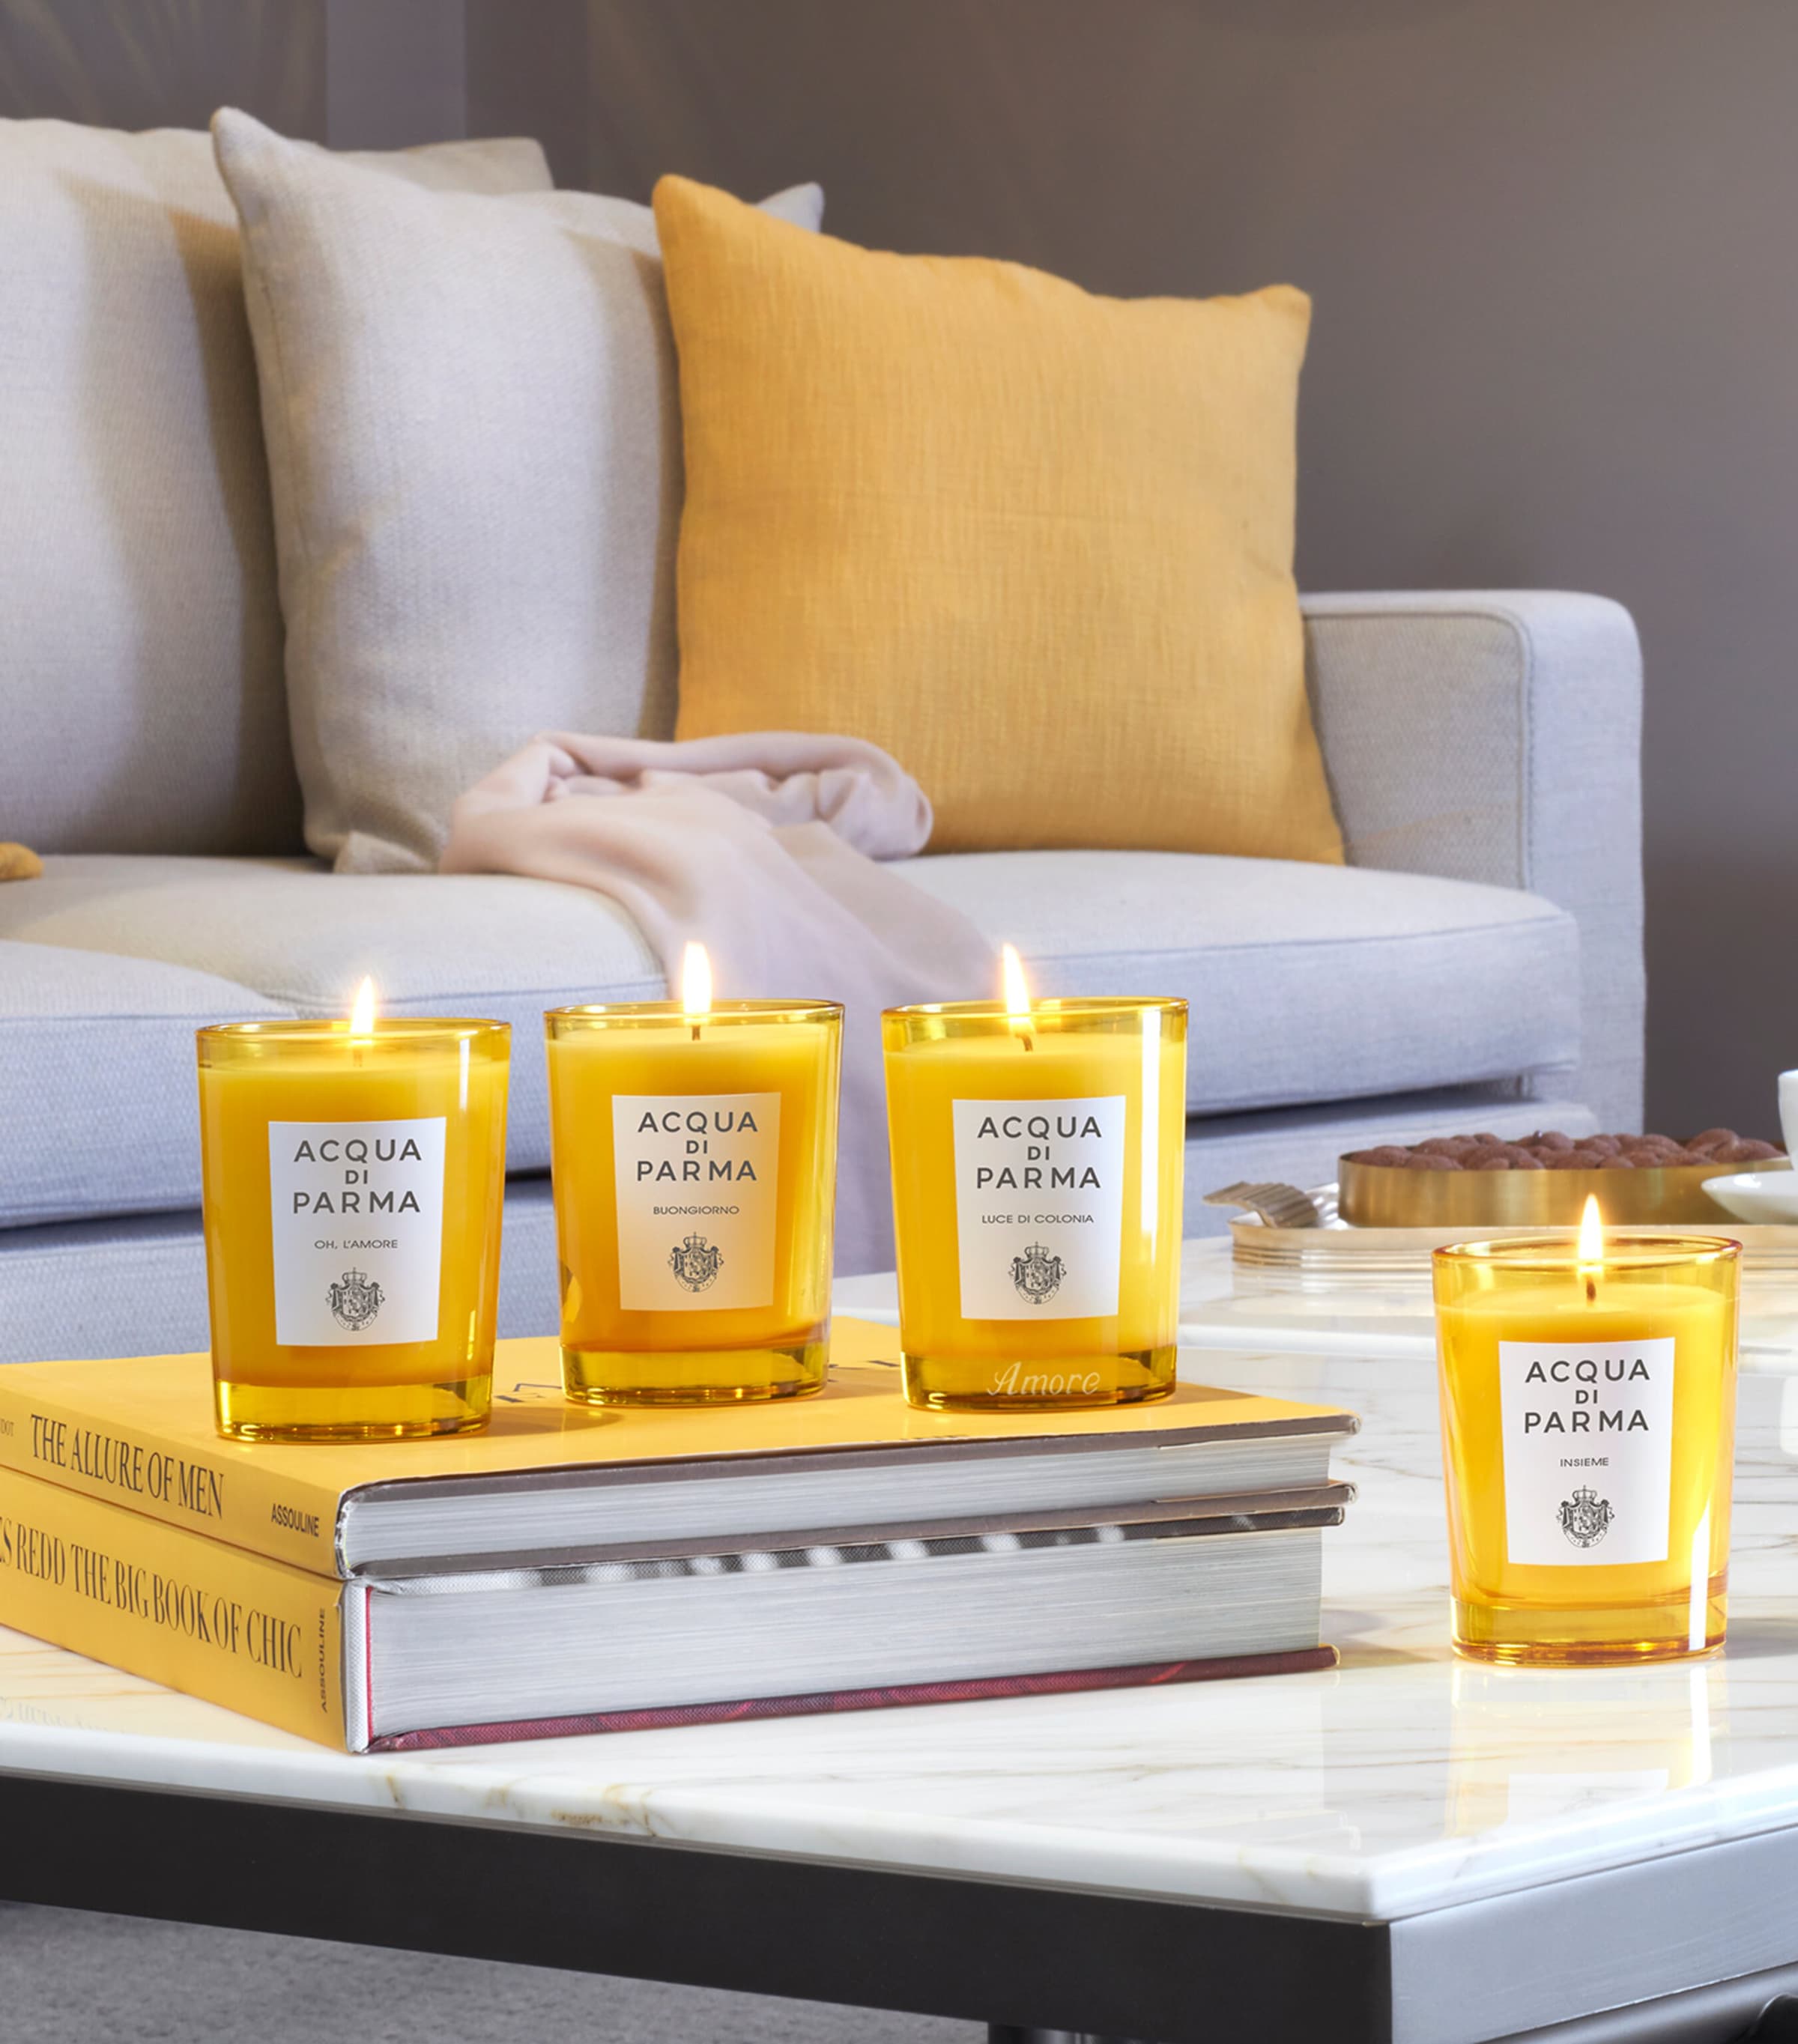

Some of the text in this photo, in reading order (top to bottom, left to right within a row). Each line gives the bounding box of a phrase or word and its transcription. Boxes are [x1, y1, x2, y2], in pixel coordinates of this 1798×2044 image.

[638, 1112, 758, 1135] ACQUA
[977, 1116, 1102, 1141] ACQUA
[294, 1138, 422, 1164] ACQUA
[685, 1140, 708, 1154] DI
[1027, 1146, 1050, 1161] DI
[345, 1169, 369, 1185] DI
[637, 1160, 757, 1182] PARMA
[976, 1167, 1101, 1189] PARMA
[293, 1190, 421, 1214] PARMA
[653, 1205, 740, 1216] BUONGIORNO
[981, 1214, 1095, 1225] LUCE DI COLONIA
[314, 1239, 399, 1250] OH, L'AMORE
[986, 1361, 1101, 1396] Amore
[1525, 1359, 1650, 1384] ACQUA
[1575, 1389, 1598, 1405] DI
[1524, 1410, 1650, 1434] PARMA
[31, 1413, 224, 1519] THE ALLURE OF MEN
[1560, 1457, 1609, 1468] INSIEME
[271, 1503, 320, 1537] ASSOULINE
[16, 1522, 65, 1586] REDD
[70, 1544, 112, 1604] THE
[115, 1559, 148, 1619] BIG
[152, 1573, 211, 1643] BOOK
[214, 1598, 243, 1654] OF
[246, 1609, 303, 1678] CHIC
[318, 1607, 328, 1714] ASSOULINE
